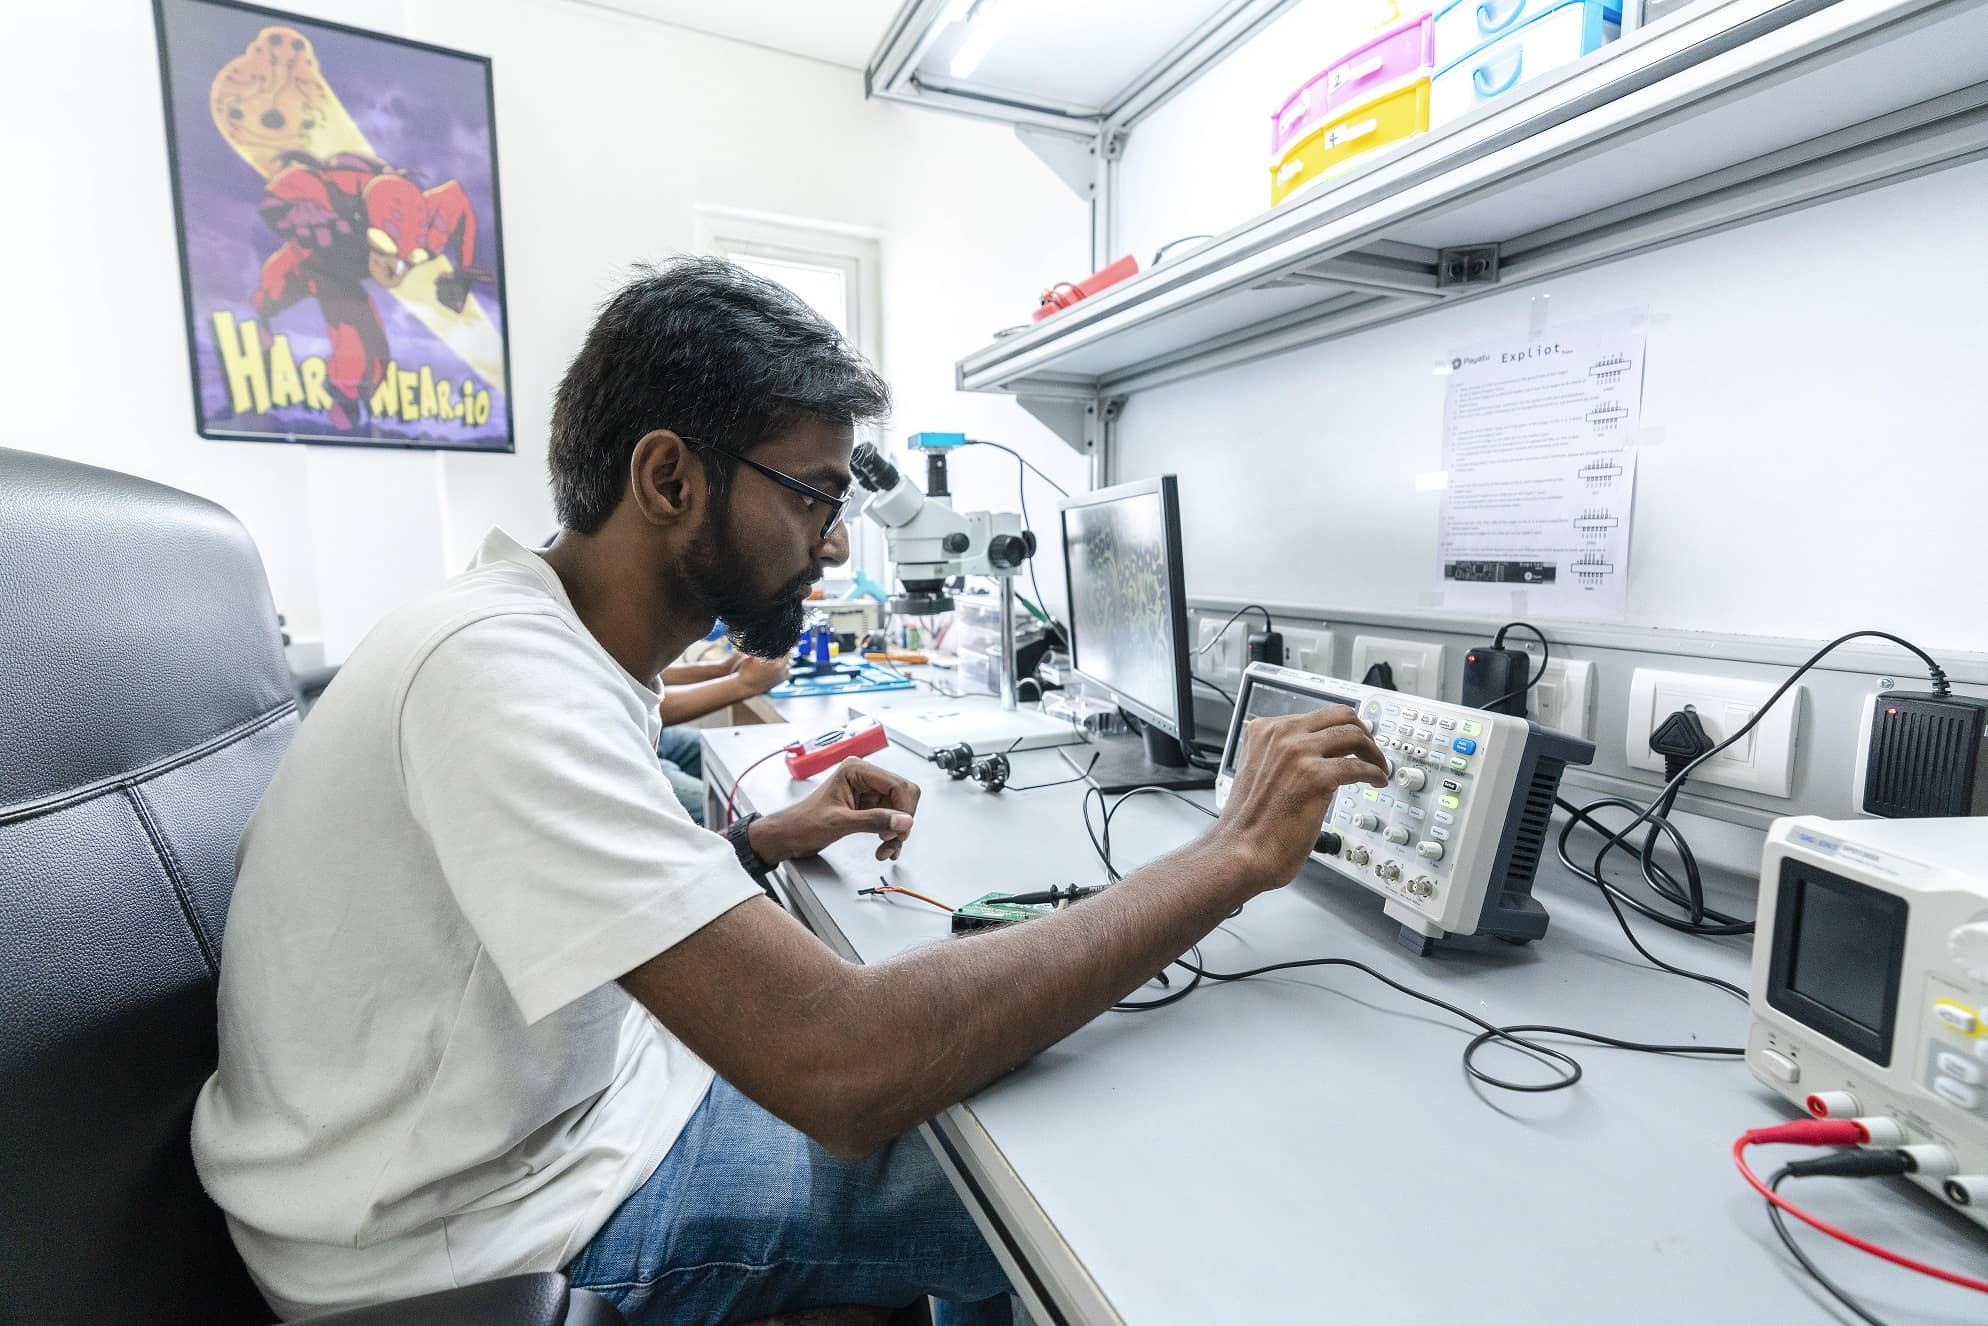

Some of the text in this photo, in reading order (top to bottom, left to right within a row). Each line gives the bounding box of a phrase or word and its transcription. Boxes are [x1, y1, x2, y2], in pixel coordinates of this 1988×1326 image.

[1333, 73, 1342, 89] 2
[1329, 131, 1339, 149] 4
[1501, 343, 1560, 364] Expliot
